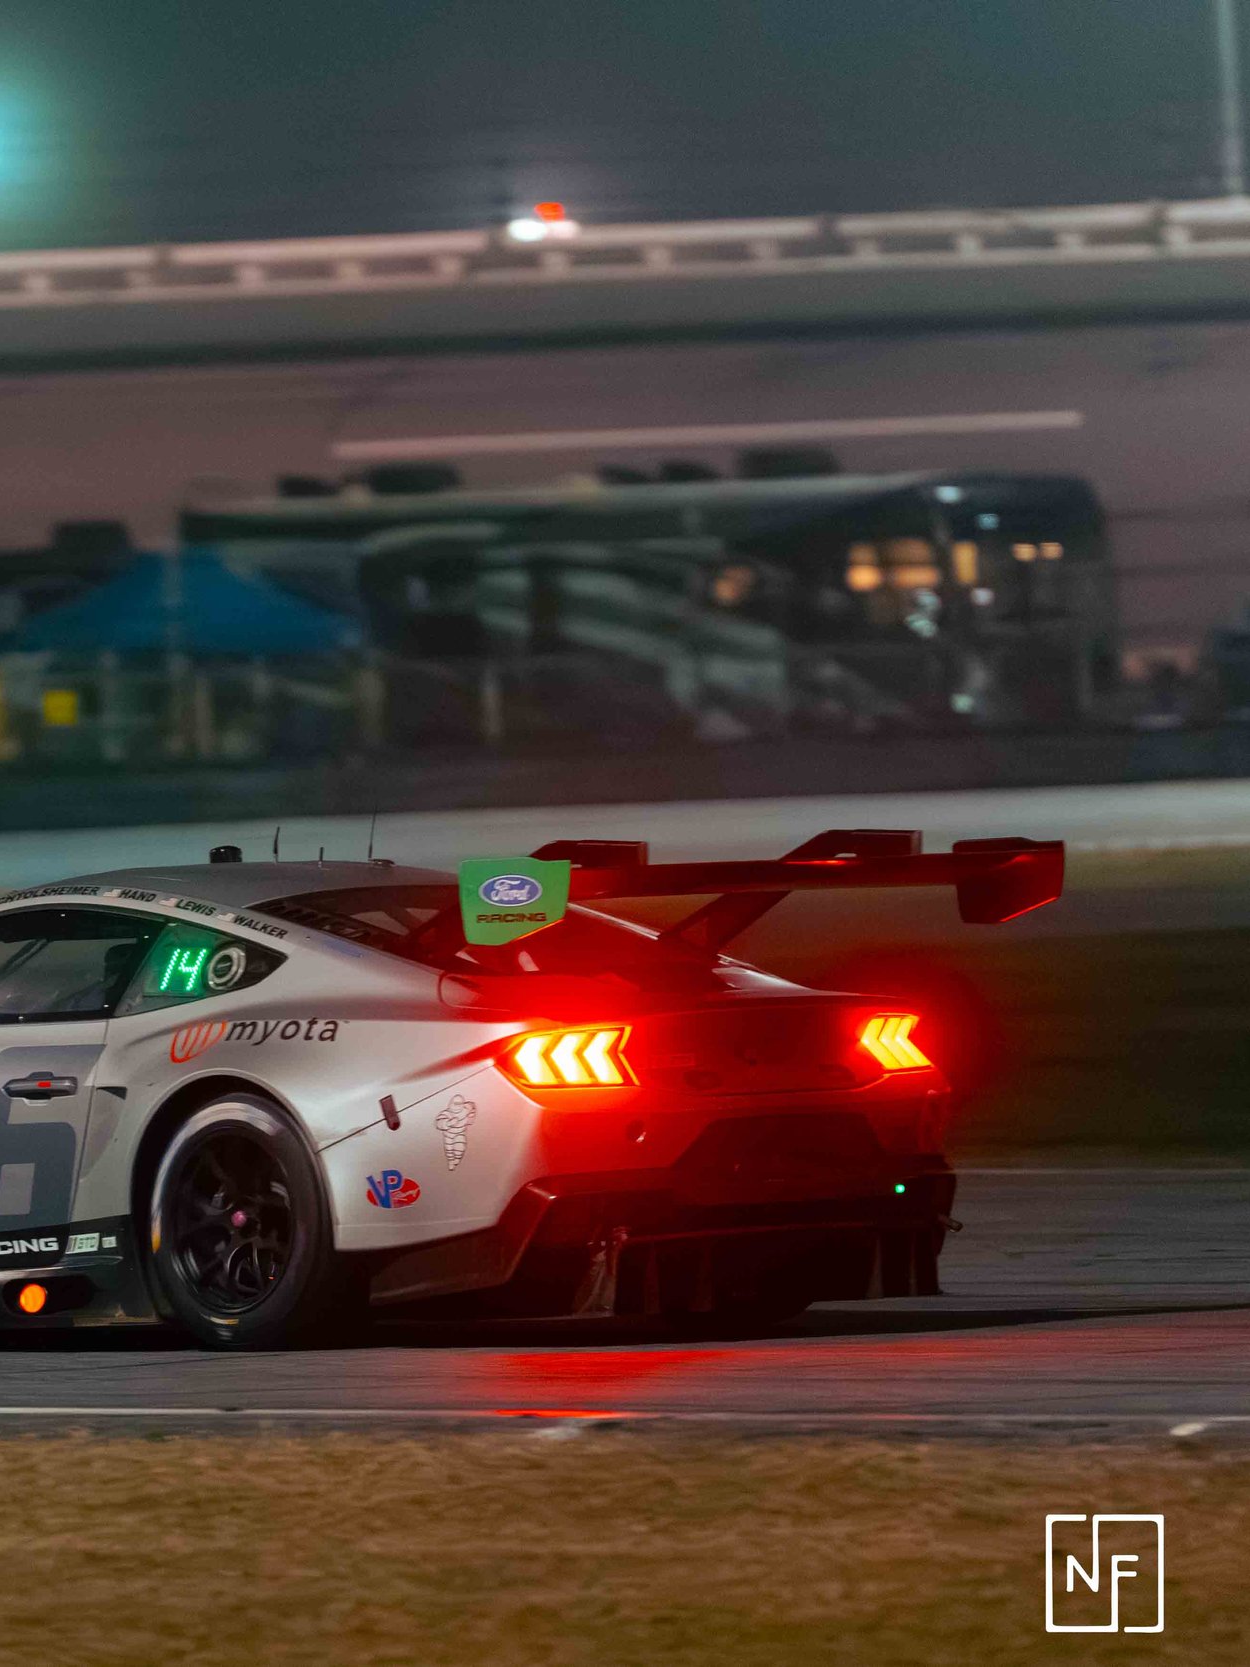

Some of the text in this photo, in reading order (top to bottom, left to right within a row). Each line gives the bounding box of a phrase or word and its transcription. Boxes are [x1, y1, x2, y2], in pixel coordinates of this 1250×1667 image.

[490, 879, 532, 901] Ford
[119, 888, 158, 903] HAND
[176, 898, 217, 917] LEWIS
[234, 914, 288, 940] WALKER
[476, 912, 547, 924] RACING
[159, 948, 207, 991] 14
[224, 1016, 339, 1046] myota
[365, 1169, 403, 1209] VP
